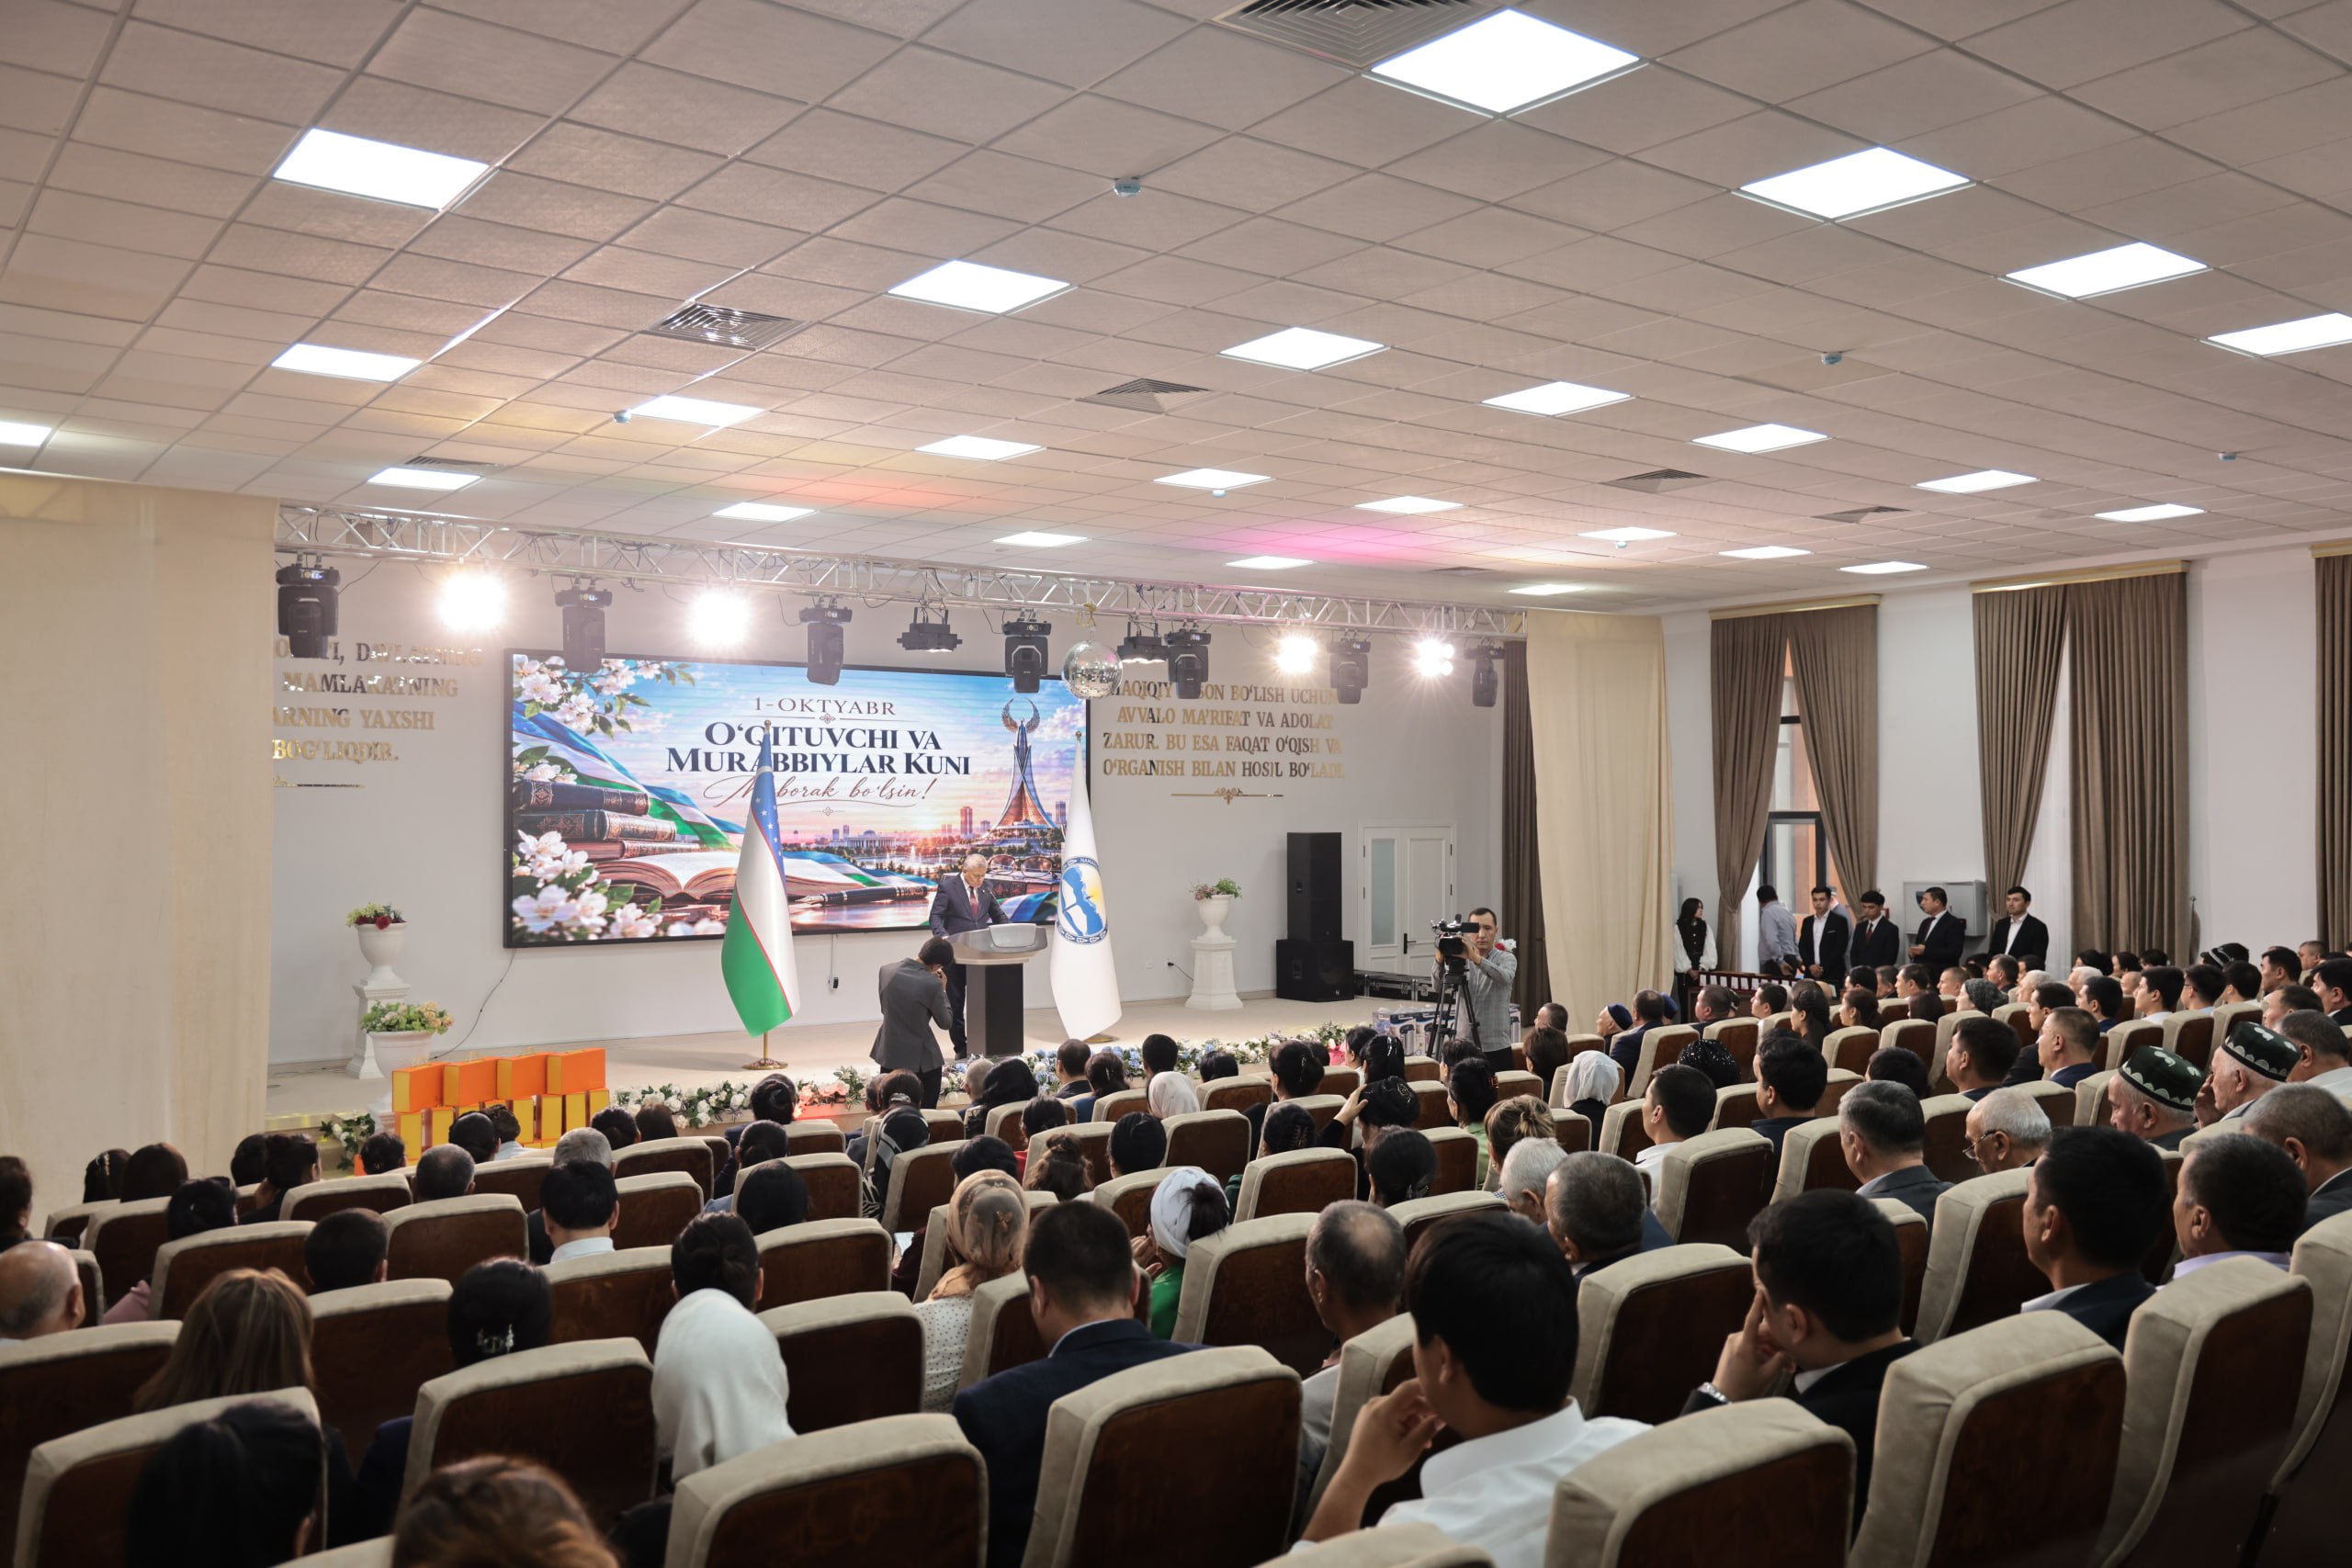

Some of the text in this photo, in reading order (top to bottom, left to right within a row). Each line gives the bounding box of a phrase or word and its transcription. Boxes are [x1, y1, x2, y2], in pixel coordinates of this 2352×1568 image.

[755, 697, 896, 716] 1-OKTYABR
[359, 709, 435, 729] YAXSHI
[1117, 705, 1176, 724] AVVALO
[1256, 711, 1275, 728] VA
[1280, 712, 1335, 729] ADOLAT
[908, 730, 944, 750] VA
[1103, 732, 1159, 750] ZARUR.
[1166, 734, 1186, 750] BU
[1192, 734, 1220, 751] ESA
[1226, 736, 1270, 755] FAQAT
[1325, 738, 1342, 754] VA
[904, 752, 971, 775] KUNI
[1192, 760, 1236, 777] BILAN
[1242, 761, 1283, 777] HOSIL
